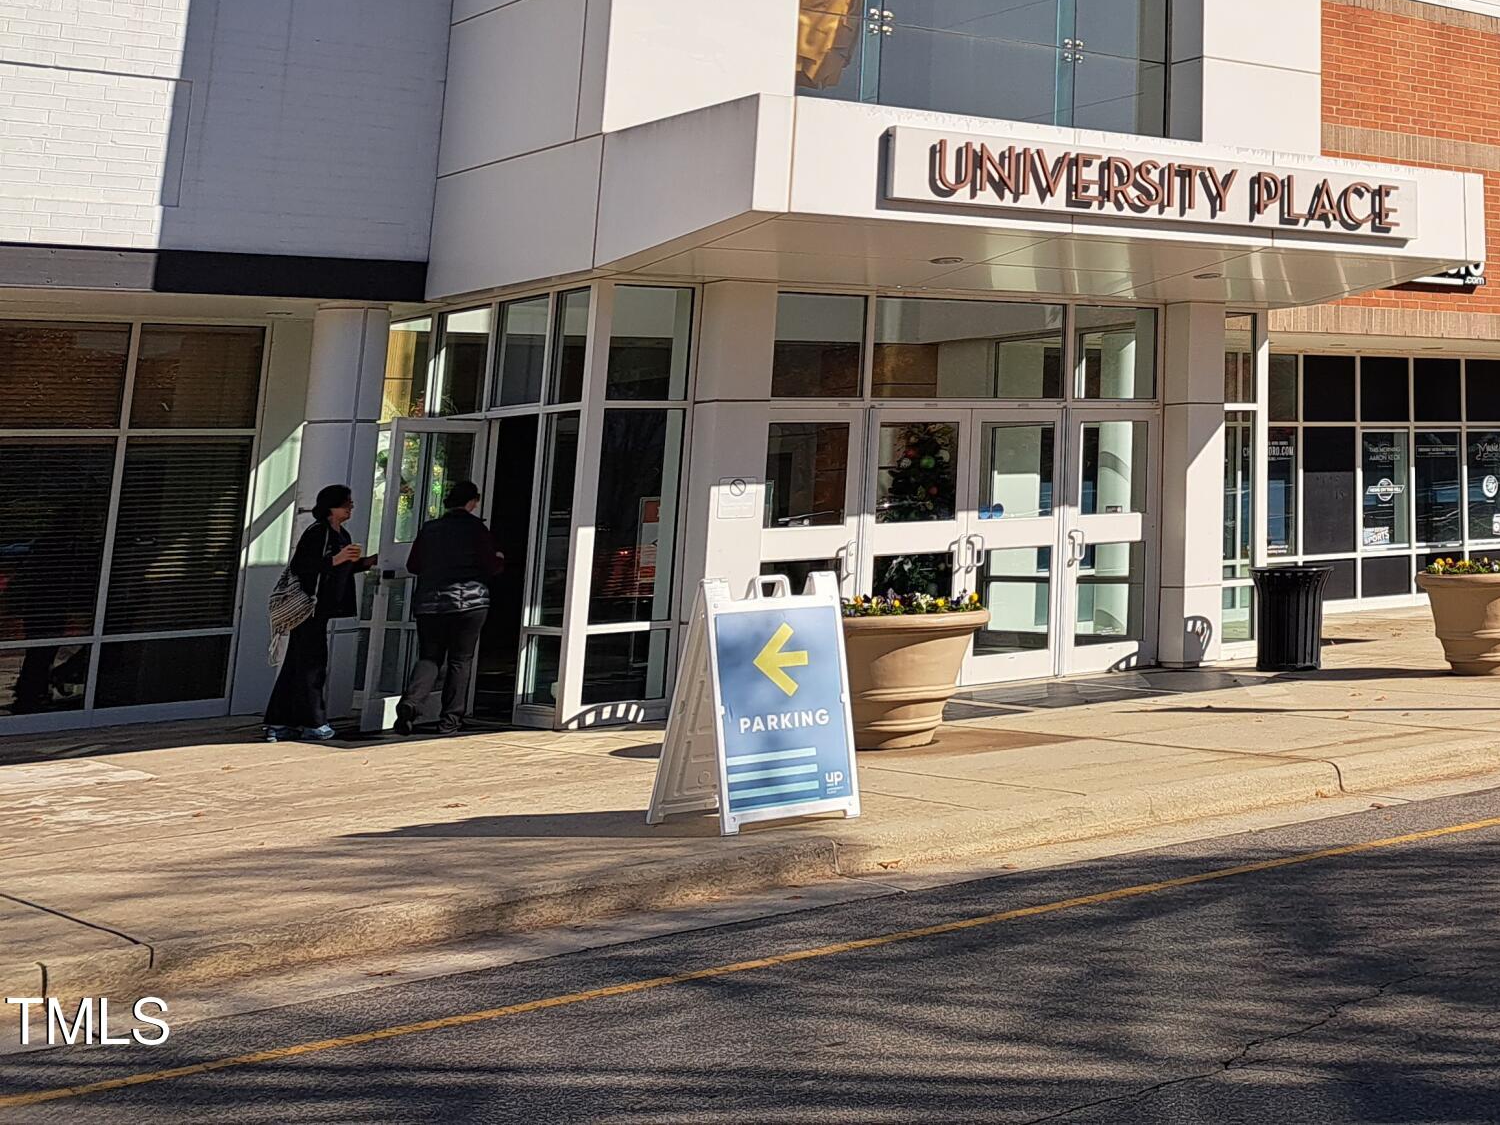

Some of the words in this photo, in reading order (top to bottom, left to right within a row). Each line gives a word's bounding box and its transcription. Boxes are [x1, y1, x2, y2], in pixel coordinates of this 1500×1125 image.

[936, 138, 1239, 212] UNIVERSITY
[1257, 171, 1400, 228] PLACE
[739, 708, 829, 734] PARKING
[825, 771, 844, 786] up
